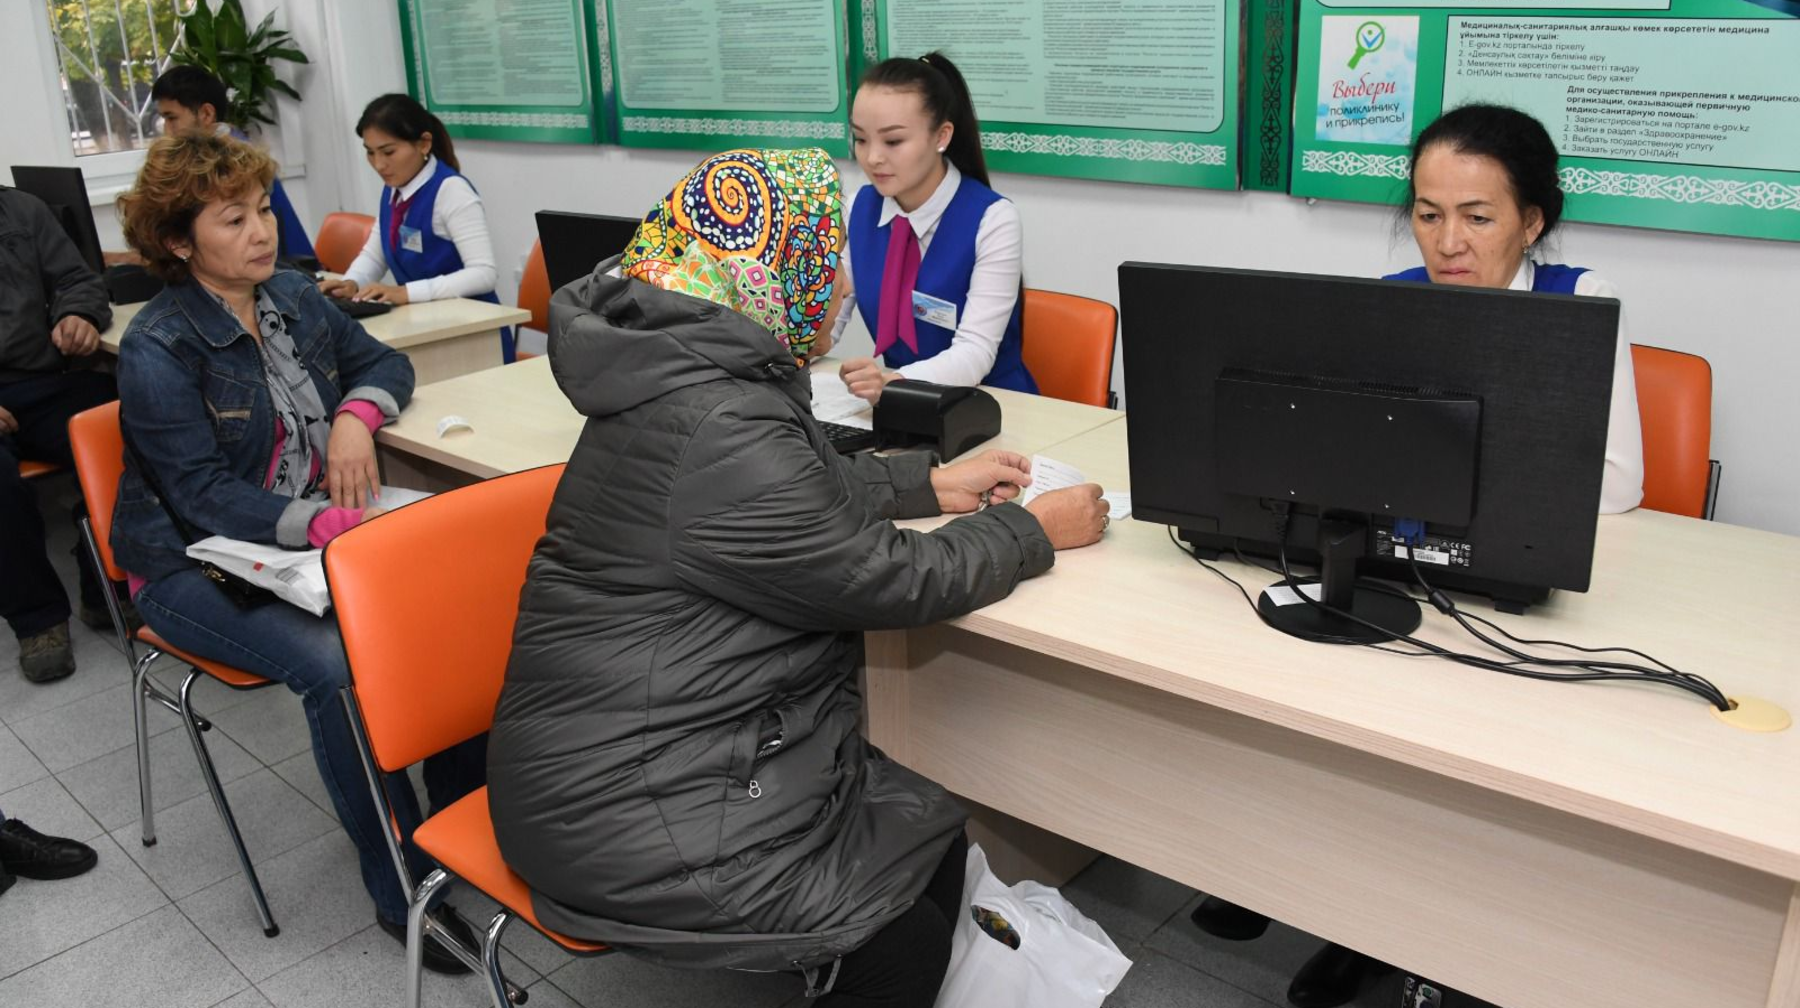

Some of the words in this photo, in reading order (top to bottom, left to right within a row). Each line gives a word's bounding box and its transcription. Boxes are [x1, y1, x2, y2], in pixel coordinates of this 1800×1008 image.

[1460, 20, 1588, 32] Медициналық-санитариялық
[1590, 23, 1631, 33] алғашқы
[1664, 25, 1715, 34] көрсететін
[1718, 26, 1770, 35] медицина
[1502, 31, 1534, 41] тіркелу
[1468, 40, 1501, 49] E-gov.kz
[1503, 42, 1553, 50] порталында
[1466, 68, 1503, 77] ОНЛАЙН
[1332, 72, 1396, 104] Выбери
[1567, 85, 1585, 94] Для
[1587, 87, 1657, 97] осуществления
[1659, 90, 1727, 100] прикрепления
[1737, 94, 1800, 103] медицинско
[1330, 102, 1400, 116] поликлинику
[1566, 96, 1626, 106] организации,
[1627, 99, 1693, 109] оказывающей
[1696, 102, 1751, 113] первичную
[1325, 120, 1333, 128] и
[1335, 112, 1405, 128] прикрепись!
[1565, 106, 1656, 118] медико-санитарную
[1657, 110, 1699, 119] помощь:
[1574, 115, 1660, 127] Зарегистрироваться
[1674, 121, 1711, 130] портале
[1712, 123, 1751, 133] e-gov.kz
[1573, 124, 1598, 133] Зайти
[1607, 128, 1637, 136] раздел
[1638, 129, 1728, 141] «Здравоохранение»
[1572, 134, 1608, 144] Выбрать
[1610, 138, 1684, 149] государственную
[1685, 142, 1714, 151] услугу
[1571, 144, 1608, 153] Заказать
[1610, 147, 1637, 156] услугу
[1638, 148, 1680, 158] ОНЛАЙН
